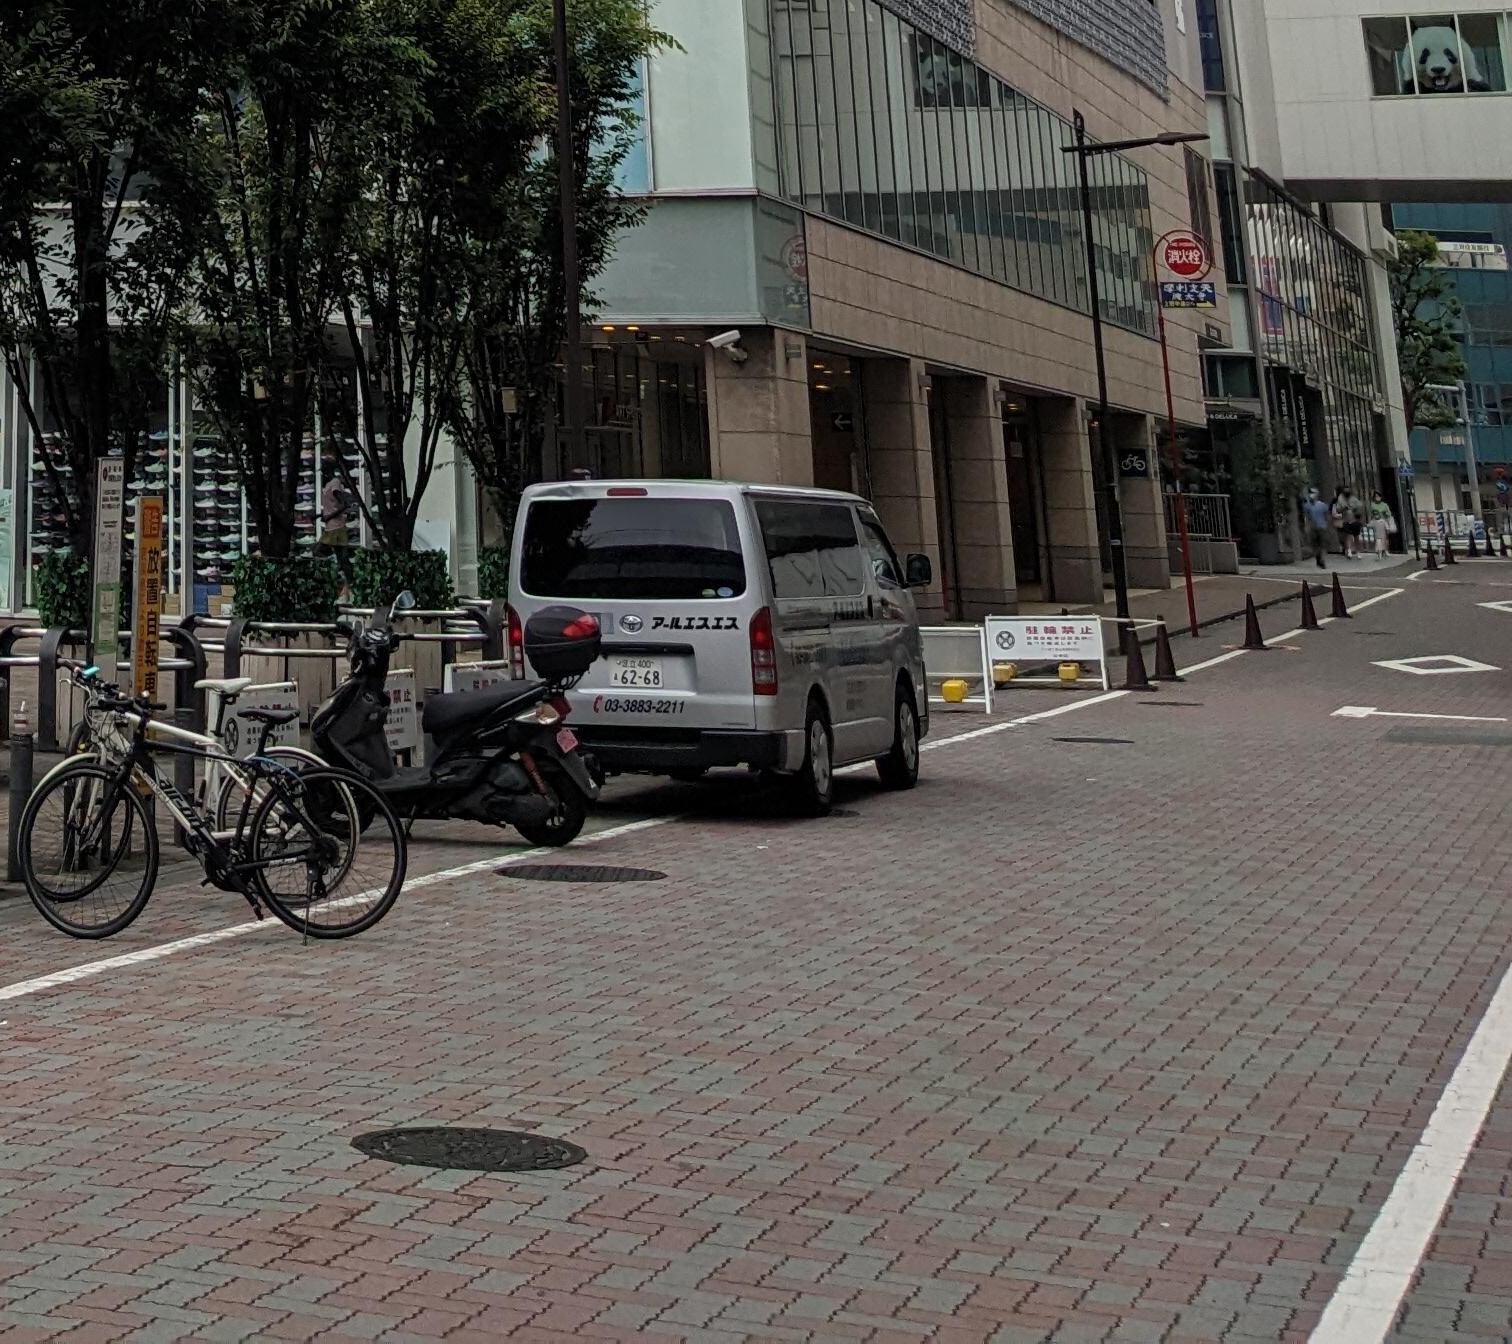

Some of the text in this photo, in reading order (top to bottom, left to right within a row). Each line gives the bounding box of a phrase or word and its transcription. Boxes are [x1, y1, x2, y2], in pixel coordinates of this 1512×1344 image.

[1168, 248, 1201, 265] 消火栓
[652, 616, 739, 630] アールエスエス
[621, 670, 660, 685] 62-68
[604, 699, 685, 714] 03-3883-2211
